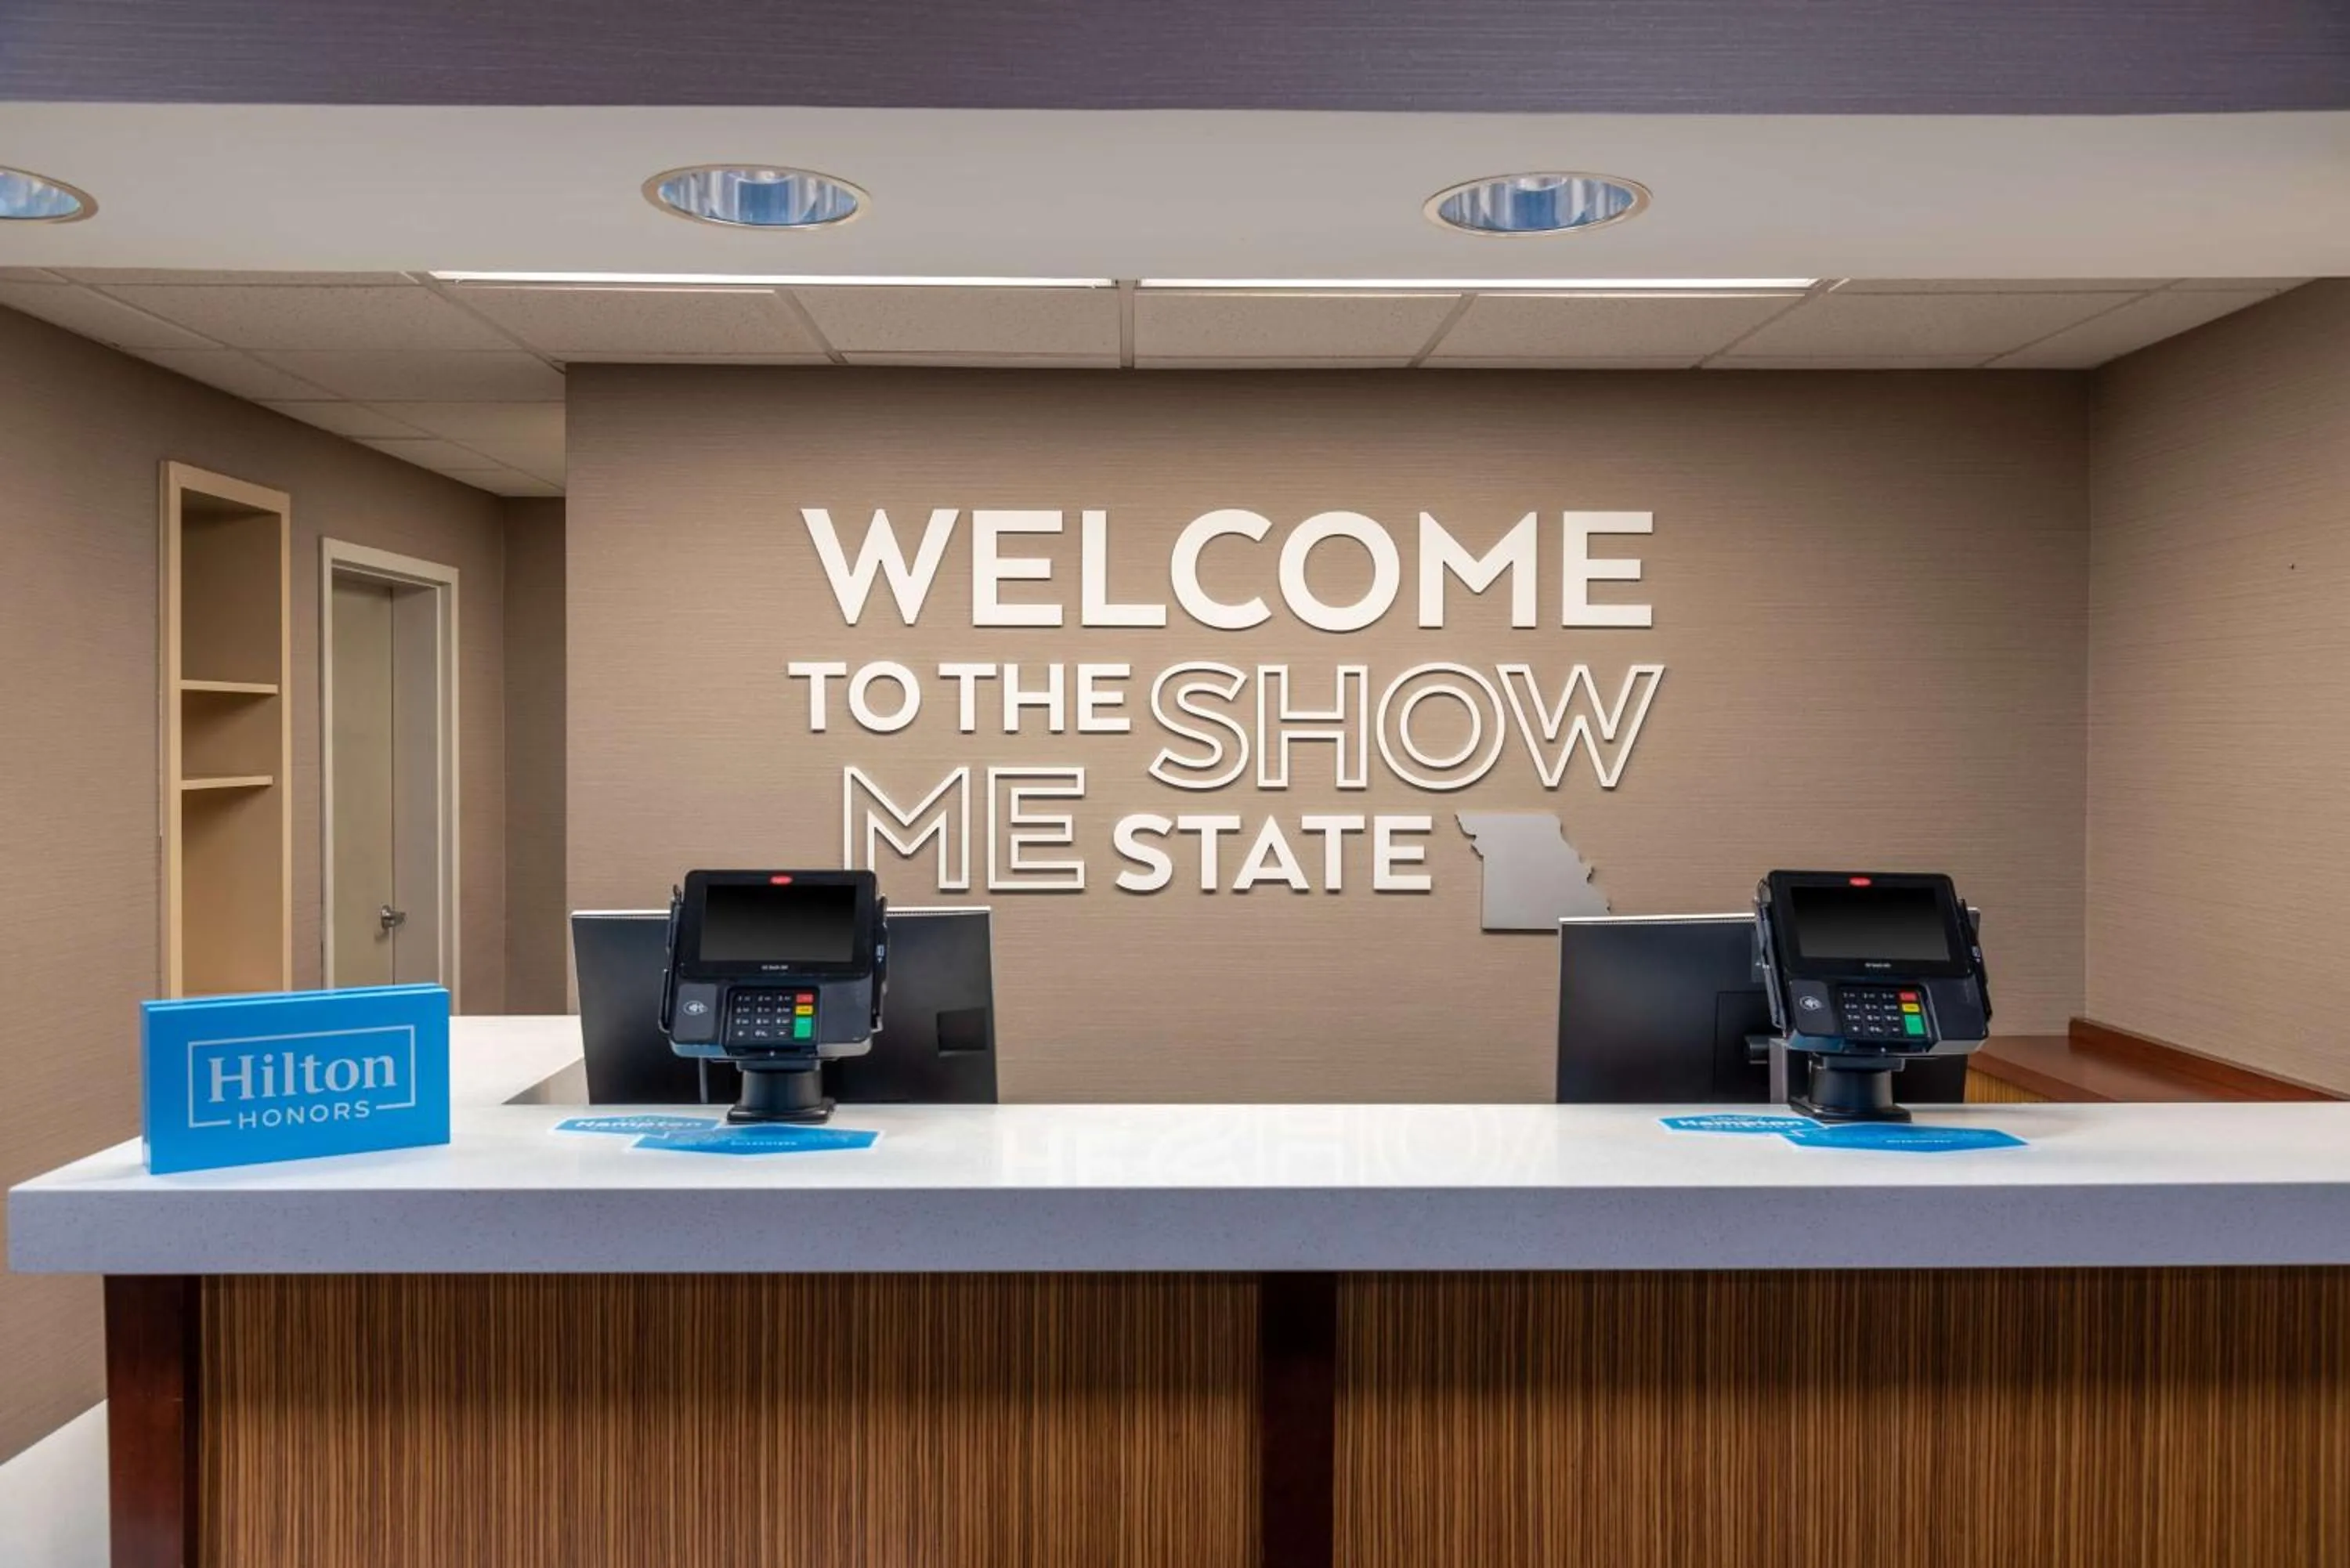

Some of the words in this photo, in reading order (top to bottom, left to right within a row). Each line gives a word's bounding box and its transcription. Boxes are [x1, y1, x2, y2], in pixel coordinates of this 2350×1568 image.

[800, 508, 1654, 631] WELCOME
[787, 659, 921, 732] TO
[937, 661, 1132, 732] THE
[1147, 659, 1665, 789] SHOW
[843, 764, 1086, 890] ME
[1112, 811, 1434, 891] STATE
[208, 1052, 397, 1104] Hilton
[238, 1100, 371, 1129] HONORS
[575, 1120, 703, 1129] Hampton
[1678, 1119, 1805, 1128] Hampton
